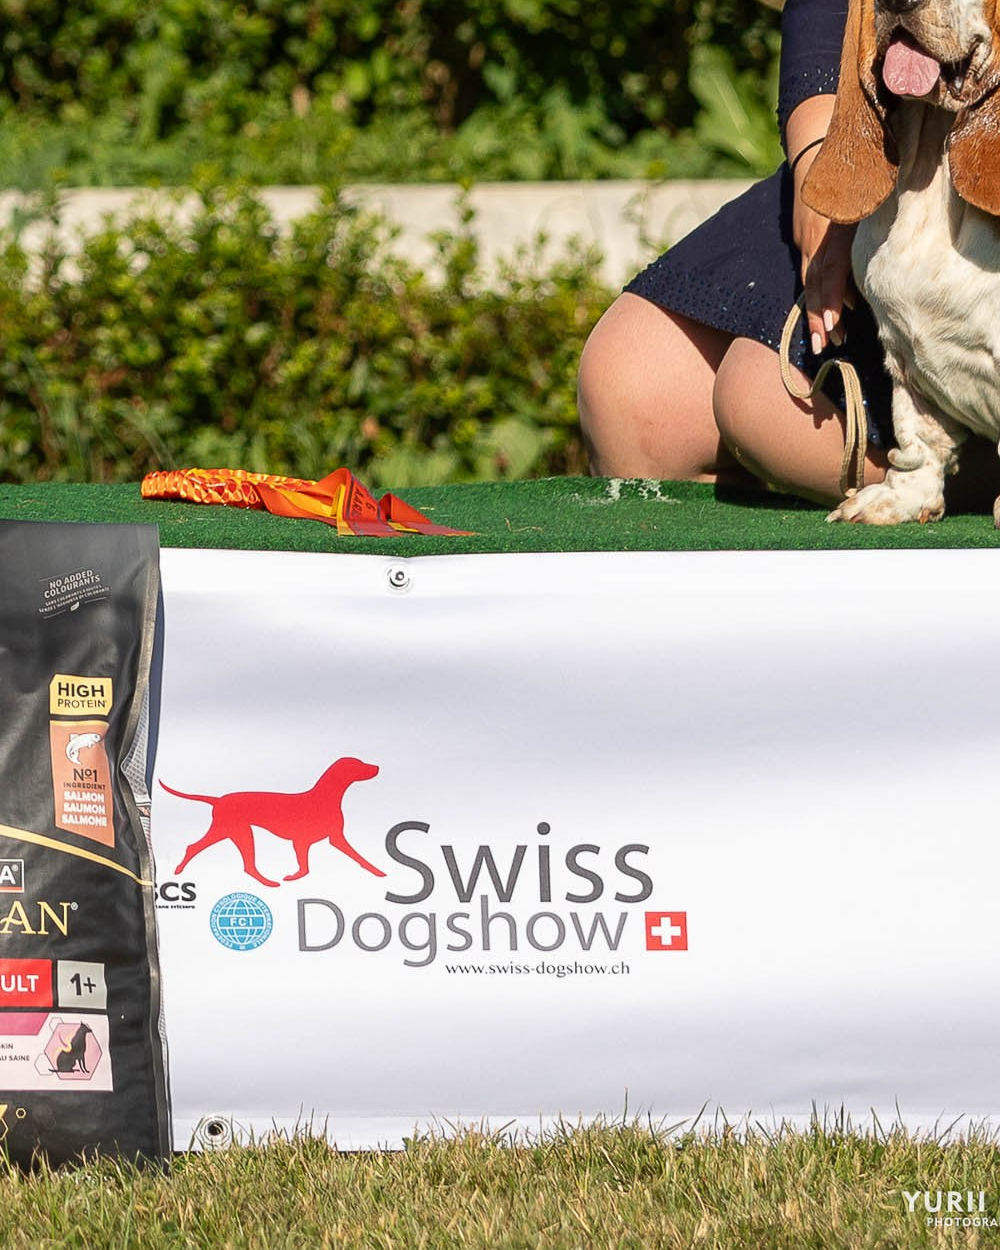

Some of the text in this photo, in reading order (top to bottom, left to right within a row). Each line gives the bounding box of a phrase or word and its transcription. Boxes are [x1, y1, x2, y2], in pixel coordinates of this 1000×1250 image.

[44, 574, 101, 598] COLOURANTS
[49, 569, 93, 590] NO ADDED
[58, 681, 105, 699] HIGH
[57, 698, 106, 709] PROTEIN
[63, 782, 106, 791] INGREDIENT
[63, 790, 105, 803] SALMON
[63, 802, 106, 815] SAUMON
[61, 814, 108, 827] SALMONE
[384, 820, 654, 905] Swiss
[230, 917, 253, 927] FCI
[297, 894, 628, 968] Dogshow
[445, 961, 631, 979] www.swiss-dogshow.ch
